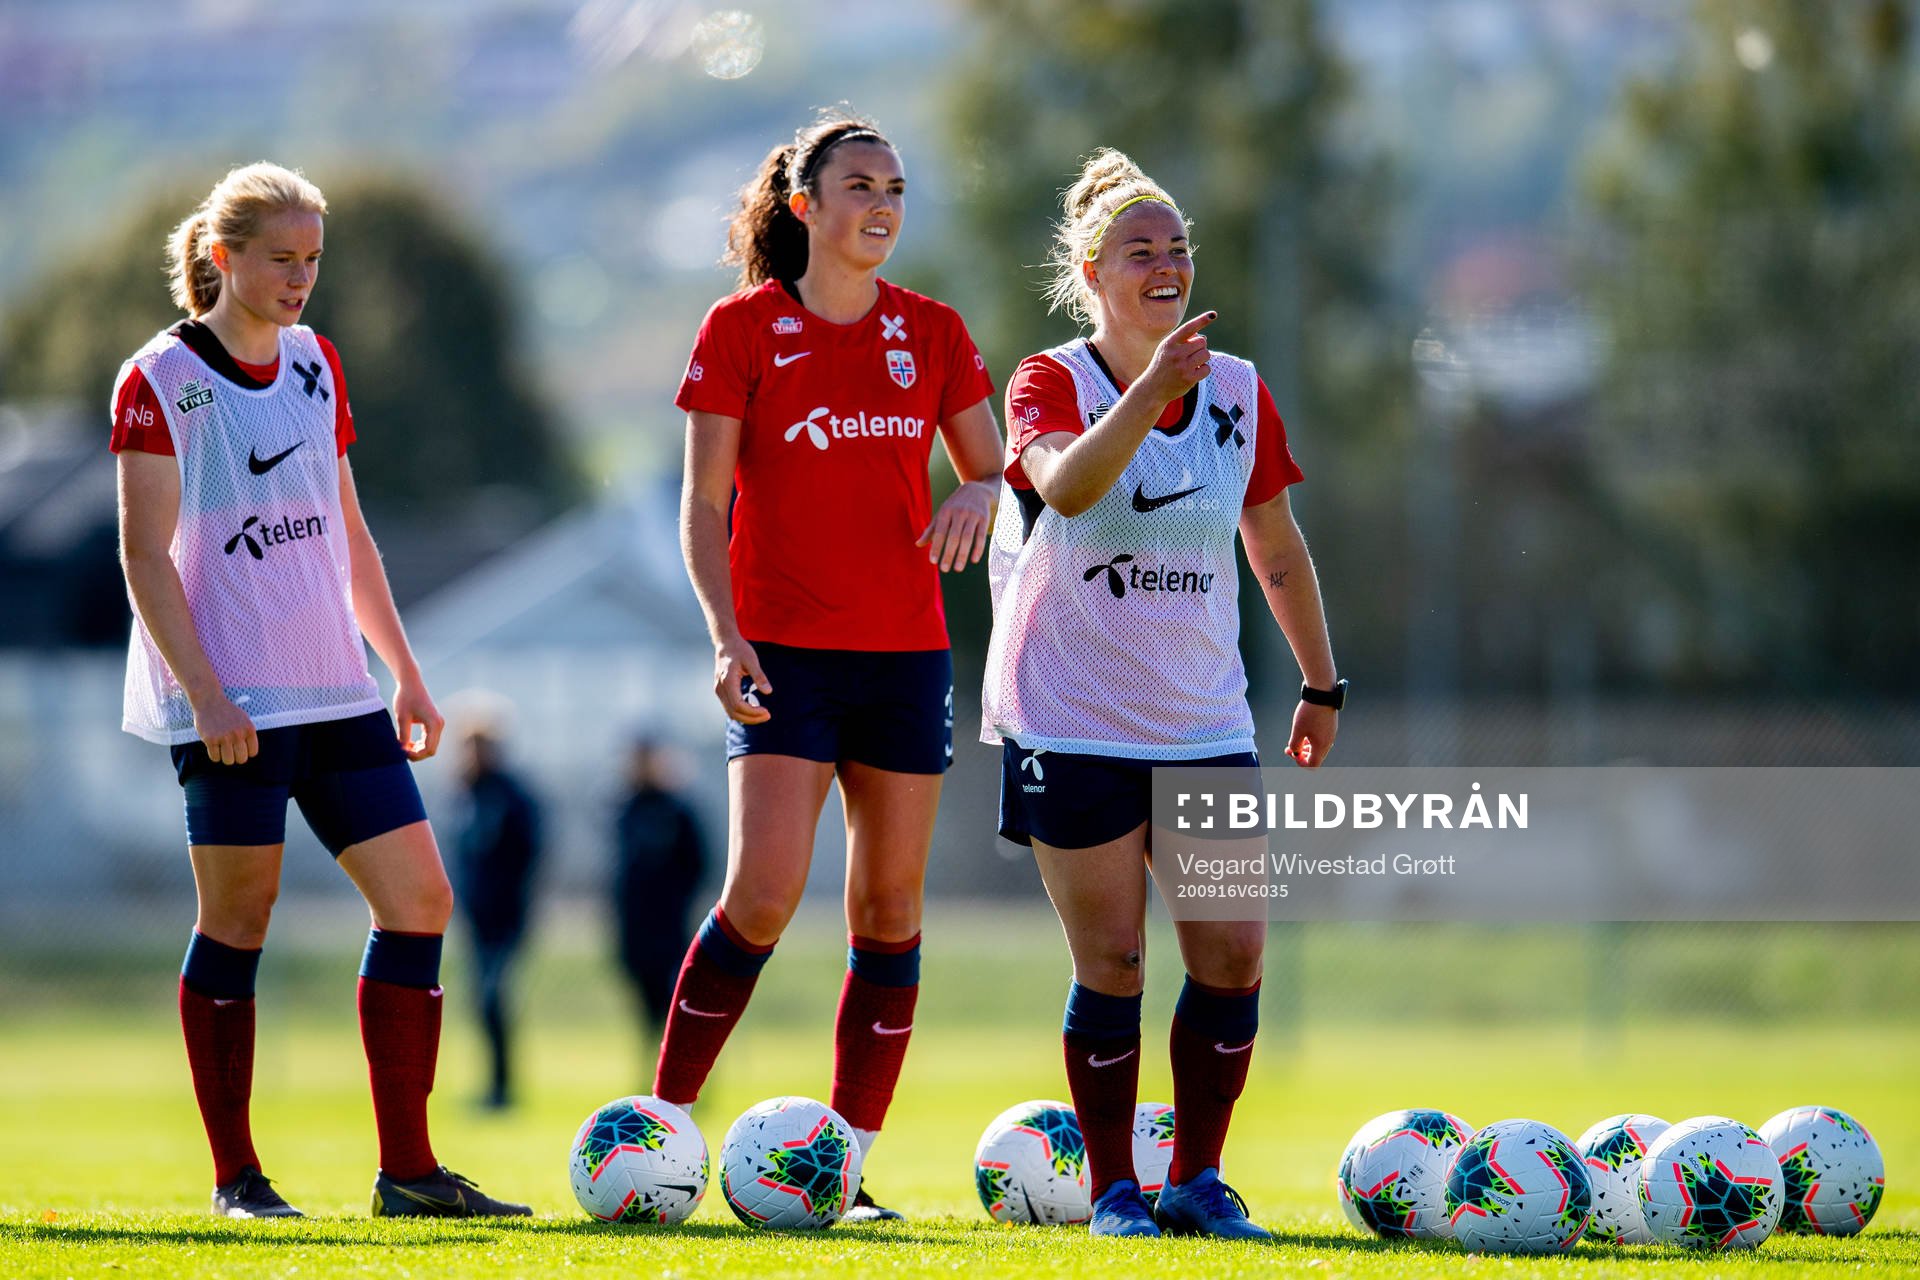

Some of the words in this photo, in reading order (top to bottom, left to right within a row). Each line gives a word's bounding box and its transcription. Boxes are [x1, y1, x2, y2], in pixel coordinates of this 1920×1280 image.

[180, 391, 213, 411] TINE
[125, 404, 154, 428] DNB
[829, 411, 925, 439] telenor
[260, 515, 328, 546] telen
[1130, 564, 1214, 593] telenor
